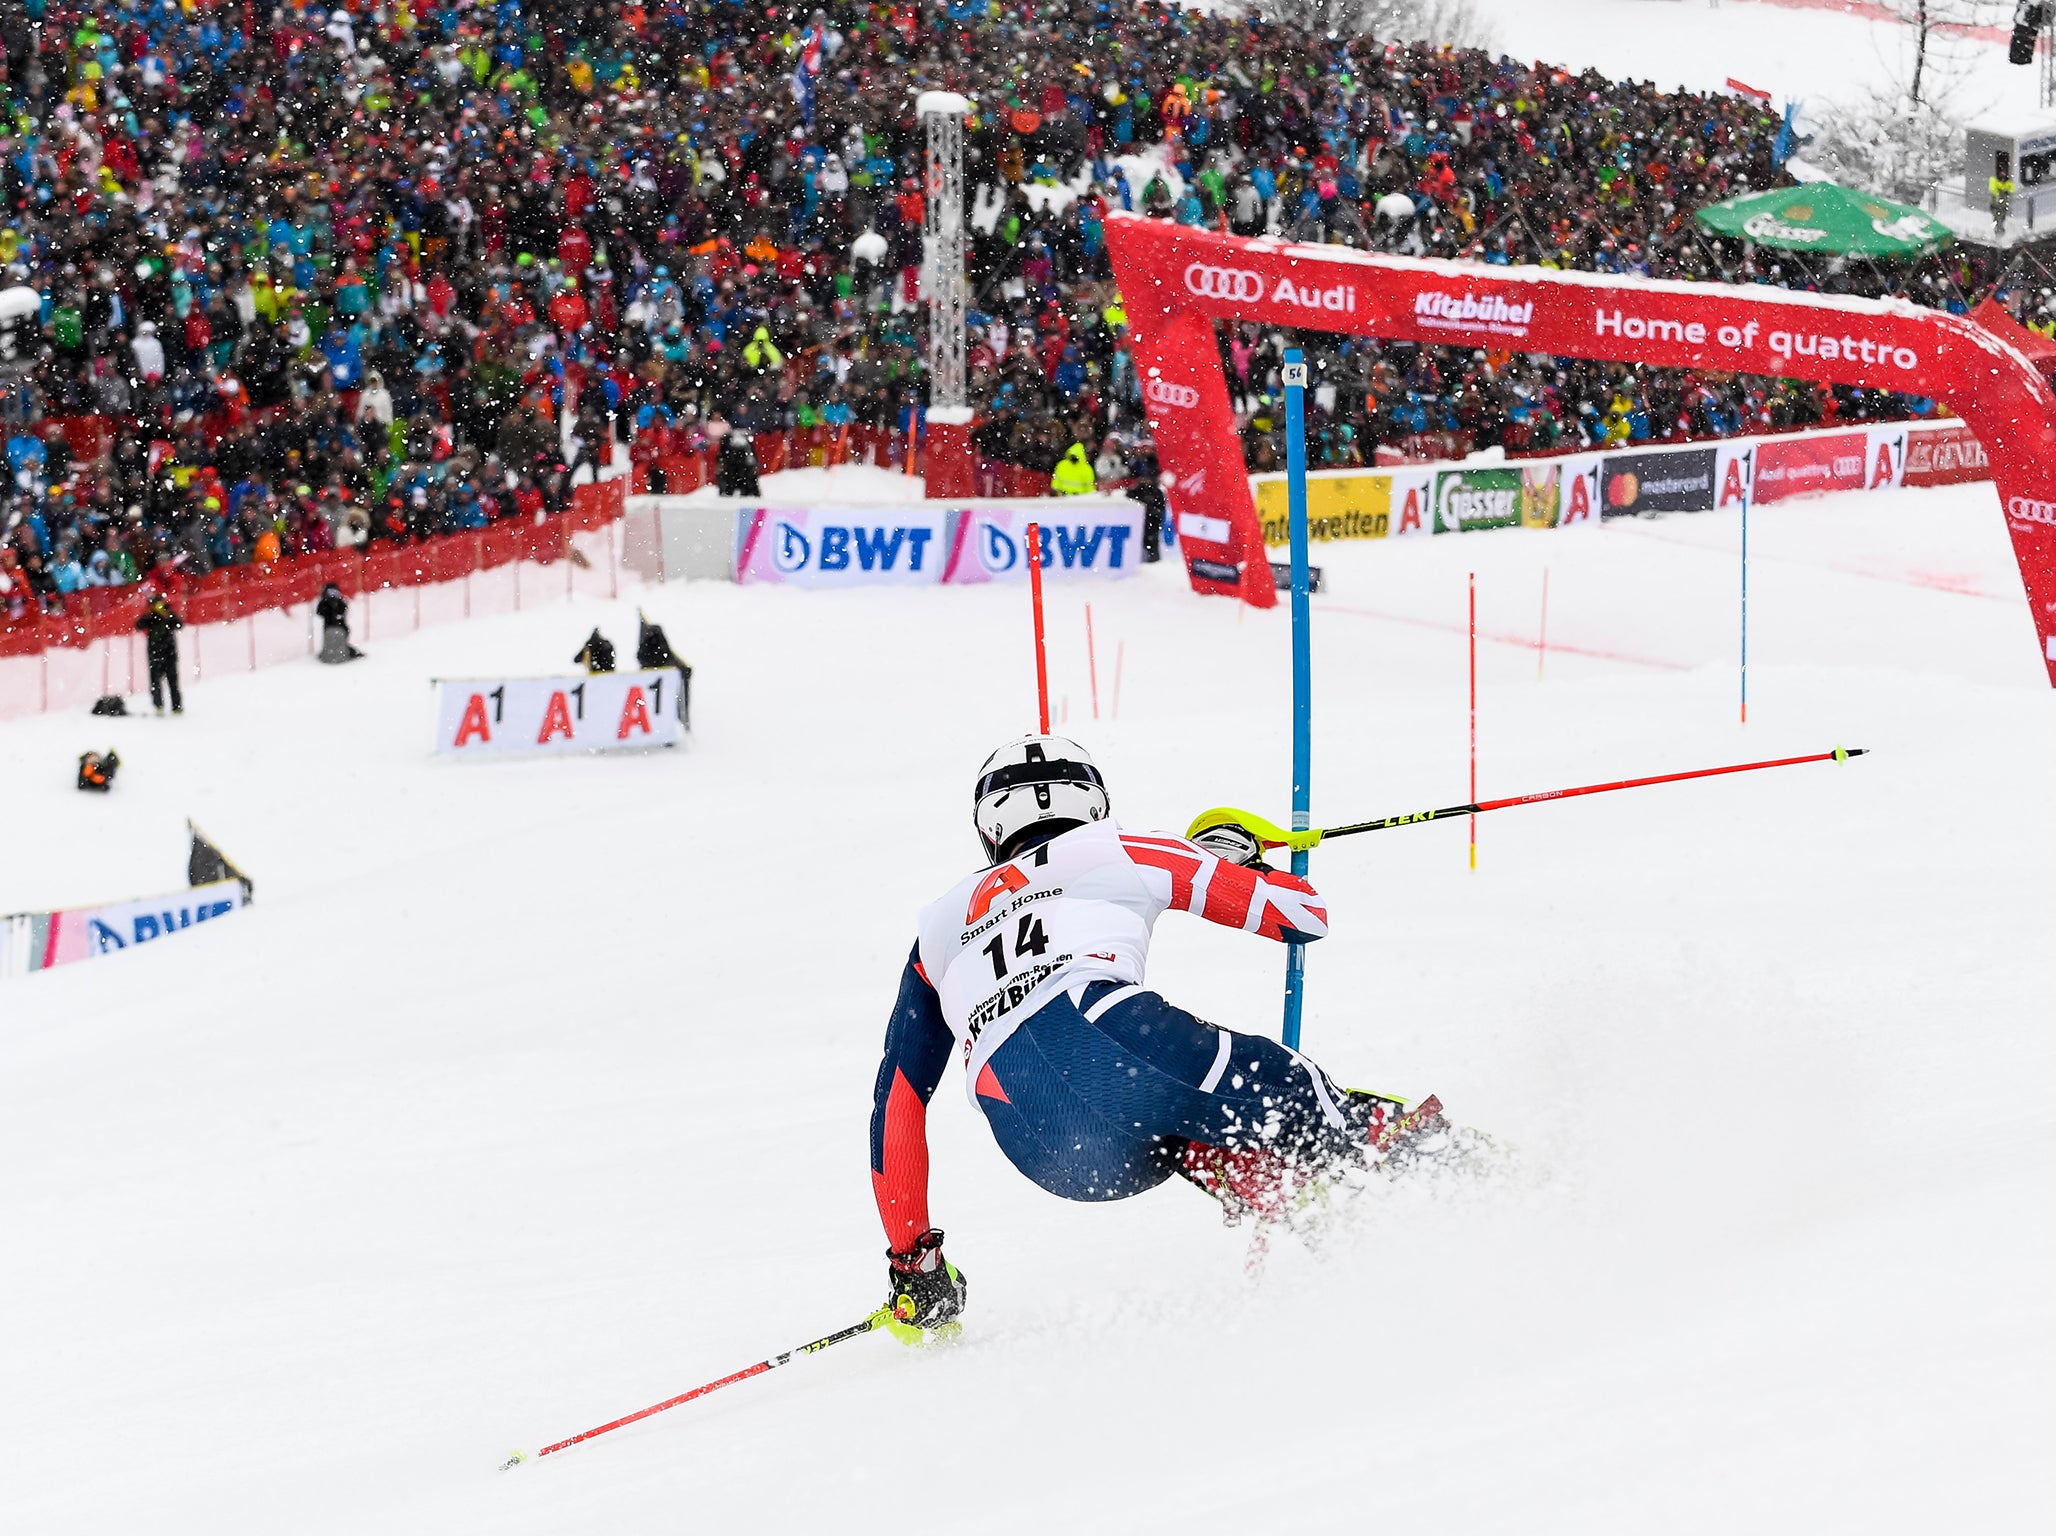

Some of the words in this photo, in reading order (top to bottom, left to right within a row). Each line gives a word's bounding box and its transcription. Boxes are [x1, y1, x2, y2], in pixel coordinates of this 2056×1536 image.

[1271, 278, 1356, 312] Audi
[1414, 290, 1534, 324] Kitzbühel
[1595, 308, 1706, 344] Home
[1716, 320, 1760, 349] of
[1768, 329, 1918, 371] quattro
[1289, 366, 1302, 380] 56
[1440, 473, 1520, 531] Gösser
[819, 526, 932, 571] BWT
[1024, 525, 1131, 569] BWT
[455, 685, 505, 748] A1
[537, 681, 586, 744] A1
[617, 676, 663, 740] A1
[1521, 790, 1563, 802] CARBON
[1384, 809, 1436, 828] LEKI
[960, 908, 1008, 946] Smart
[1011, 886, 1064, 913] Home
[982, 912, 1050, 981] 14
